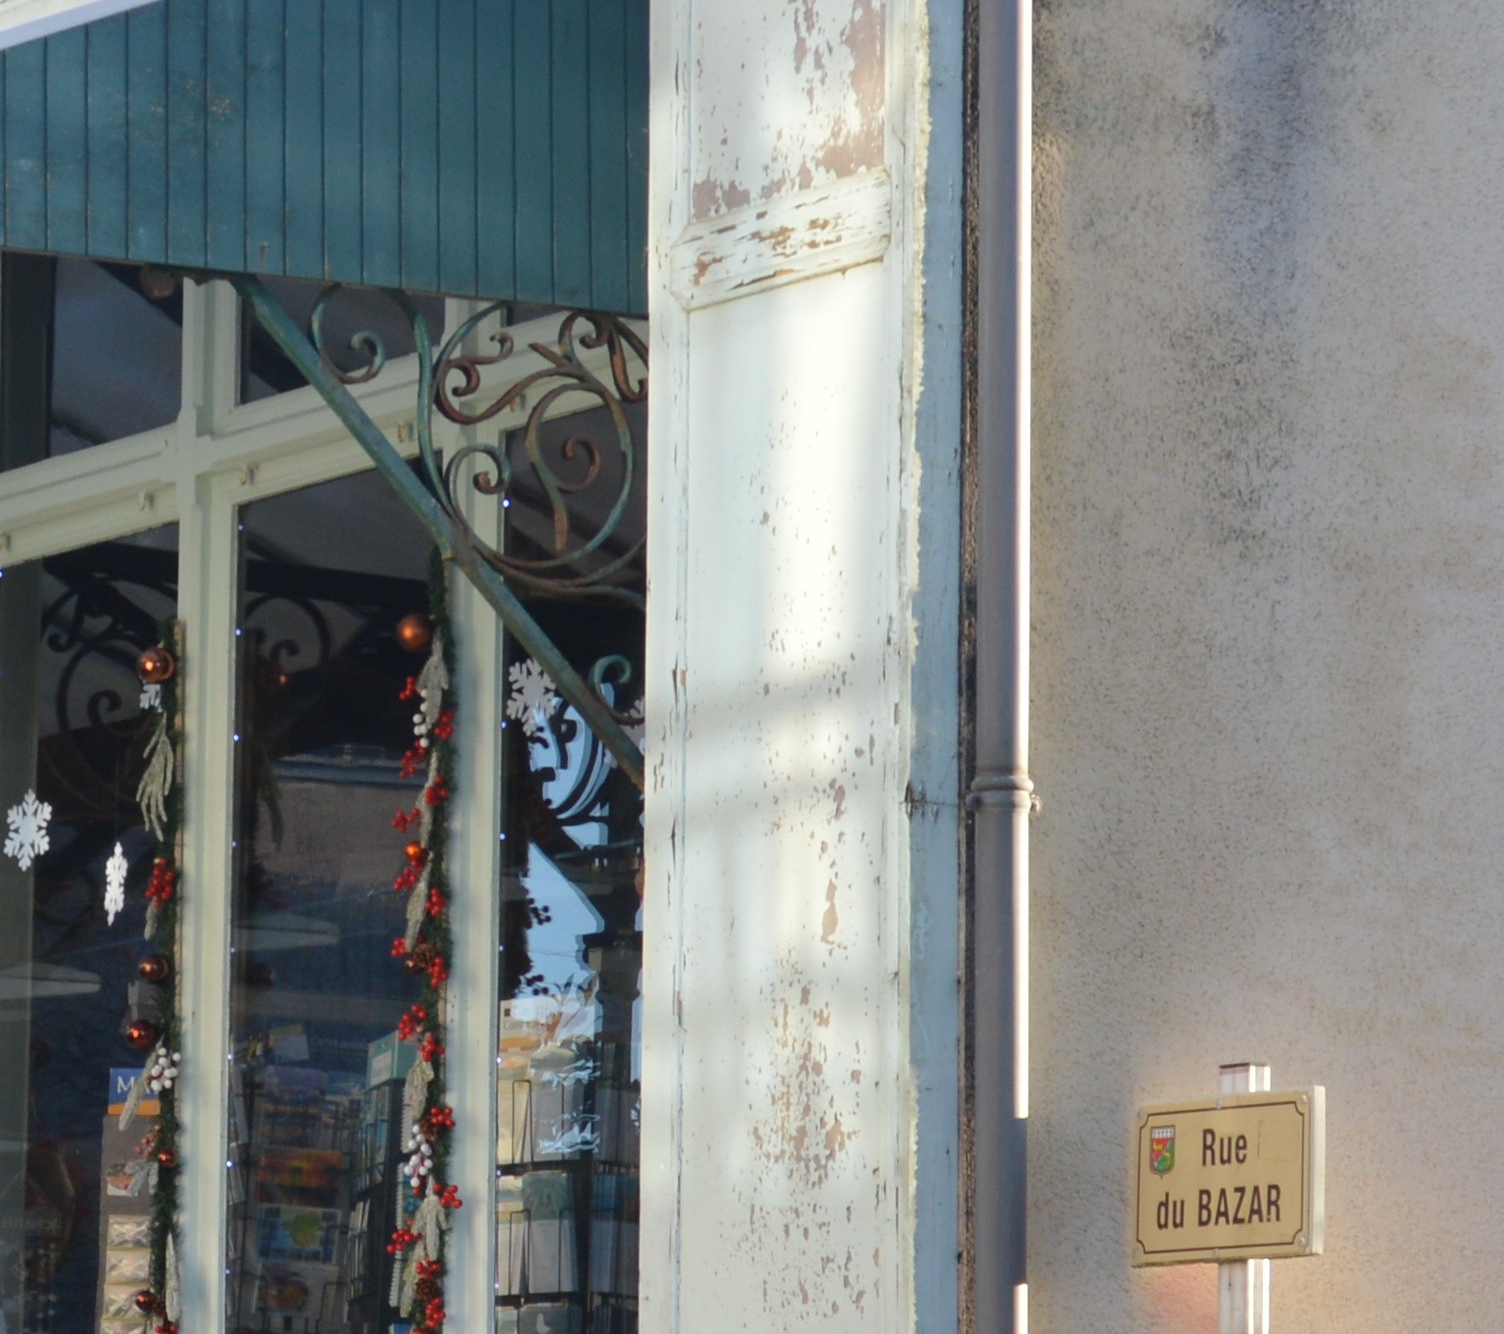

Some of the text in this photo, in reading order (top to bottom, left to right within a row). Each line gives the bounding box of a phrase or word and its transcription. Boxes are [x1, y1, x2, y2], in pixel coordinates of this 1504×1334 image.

[1201, 1128, 1248, 1167] Rue
[1156, 1183, 1281, 1230] du BAZAR
